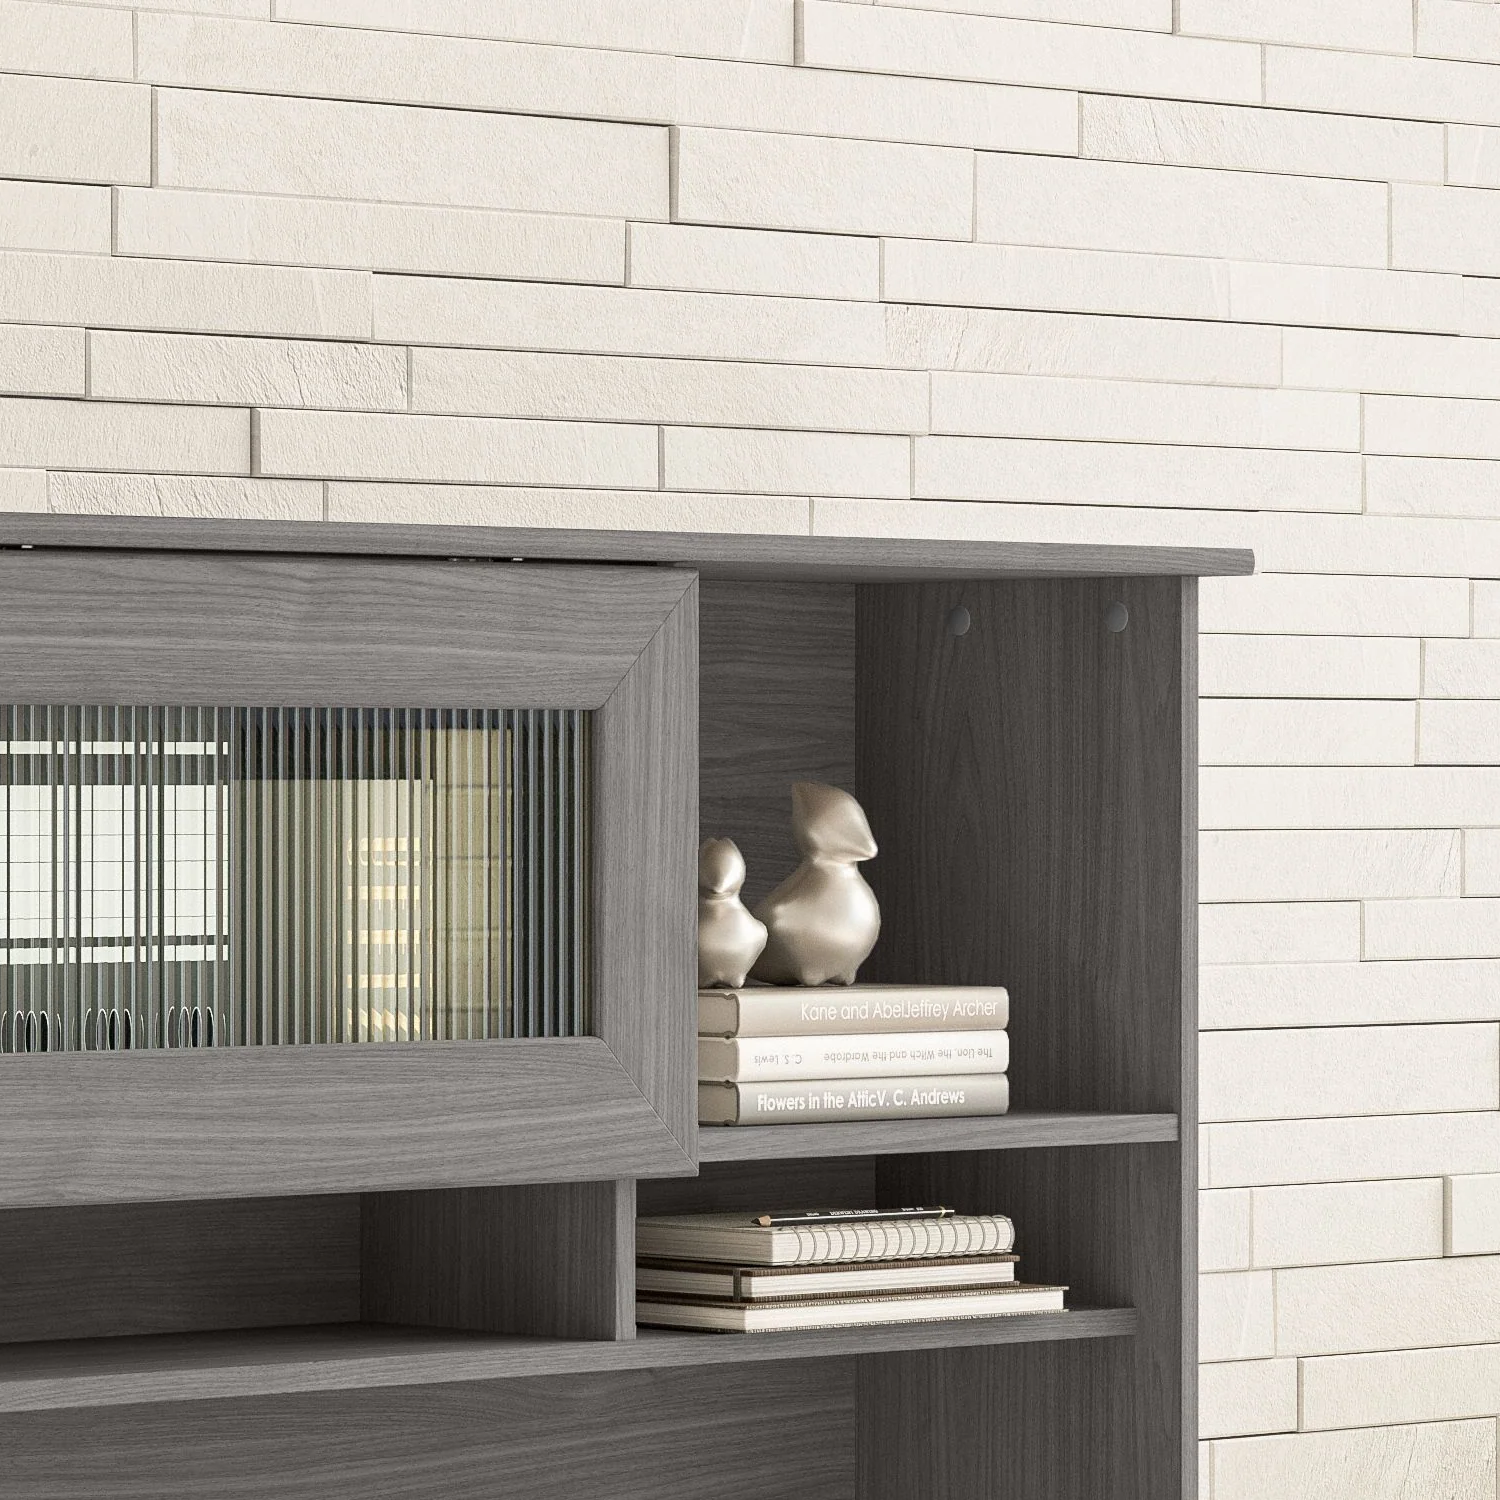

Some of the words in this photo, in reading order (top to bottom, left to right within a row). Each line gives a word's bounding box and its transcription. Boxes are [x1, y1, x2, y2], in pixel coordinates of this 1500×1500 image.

[801, 1003, 837, 1021] Kane
[841, 1001, 869, 1020] and
[953, 998, 998, 1017] Archer
[823, 1052, 870, 1063] Wardrobe
[872, 1051, 887, 1062] the
[889, 1050, 908, 1062] and
[910, 1050, 935, 1061] Witch
[937, 1049, 952, 1060] the
[978, 1047, 993, 1058] The
[754, 1055, 779, 1067] Lewis
[757, 1094, 806, 1112] Flowers
[808, 1092, 820, 1110] in
[823, 1091, 845, 1109] the
[893, 1088, 907, 1106] C.
[910, 1087, 965, 1106] Andrews
